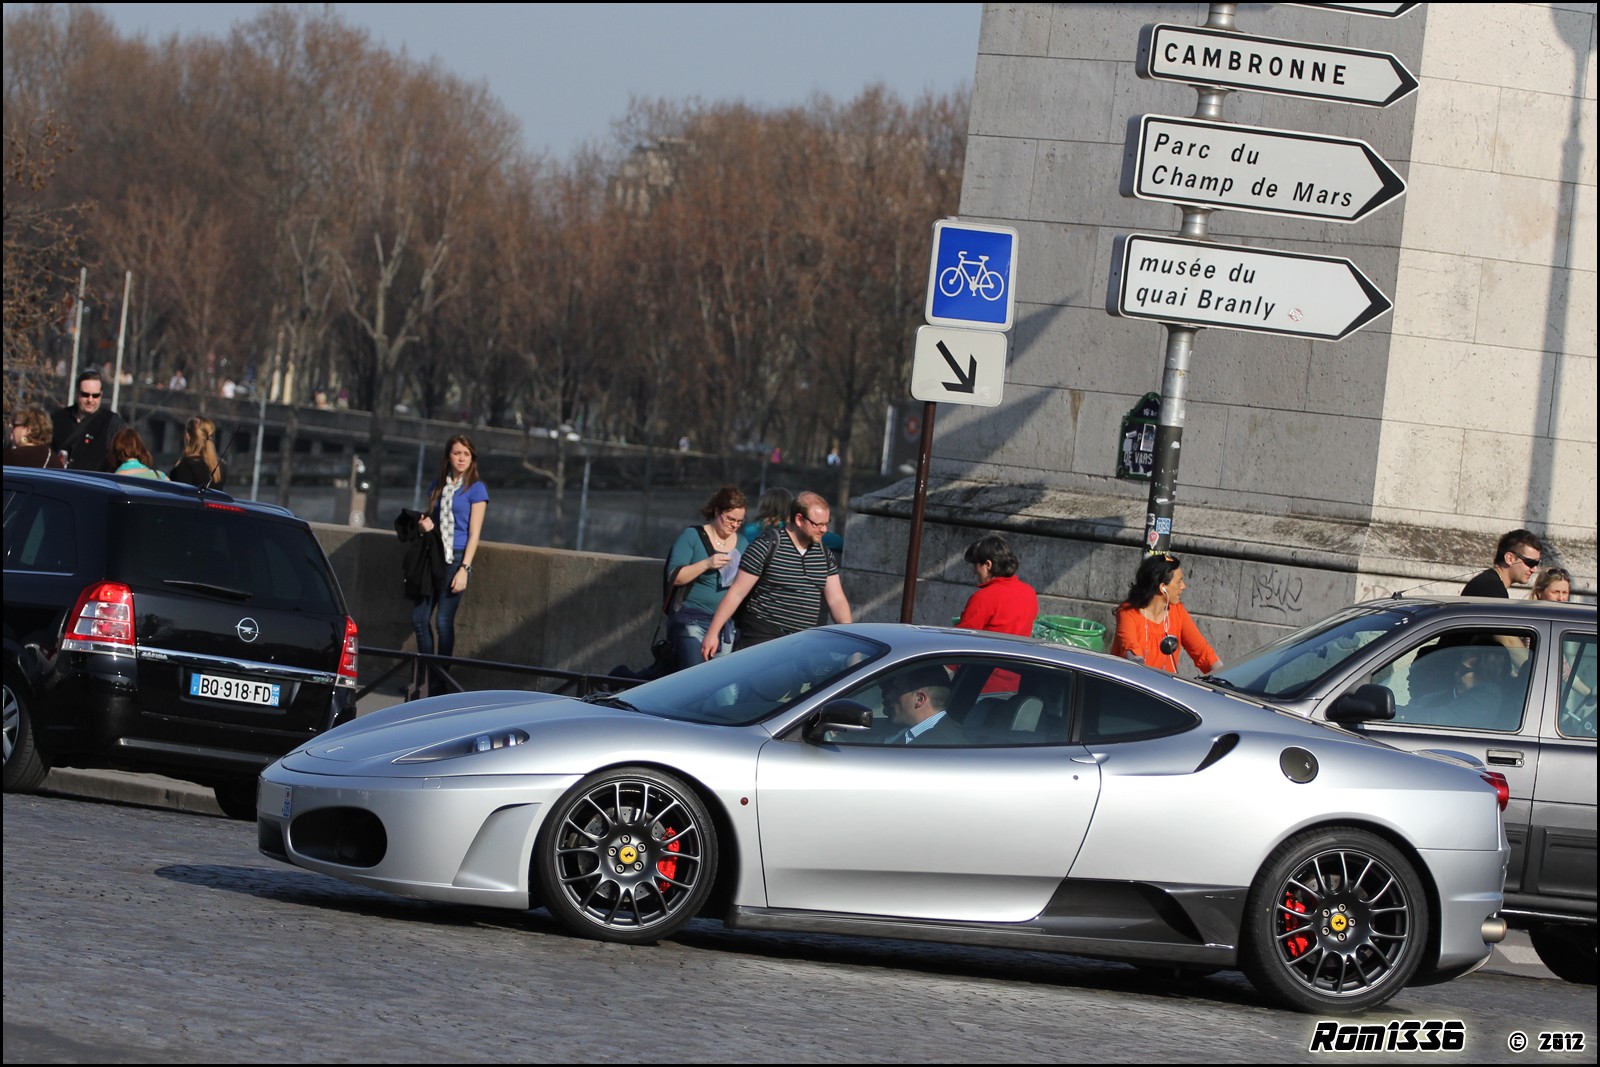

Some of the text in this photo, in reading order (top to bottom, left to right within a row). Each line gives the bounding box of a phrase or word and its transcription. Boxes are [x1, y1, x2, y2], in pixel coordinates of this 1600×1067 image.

[1164, 42, 1347, 86] CAMBRONNE
[1153, 132, 1260, 165] Parc du
[1151, 164, 1353, 207] Champ de Mars
[1139, 256, 1256, 284] musée du
[1136, 286, 1188, 307] quai
[1197, 289, 1276, 321] Branly
[1134, 452, 1153, 465] VARS
